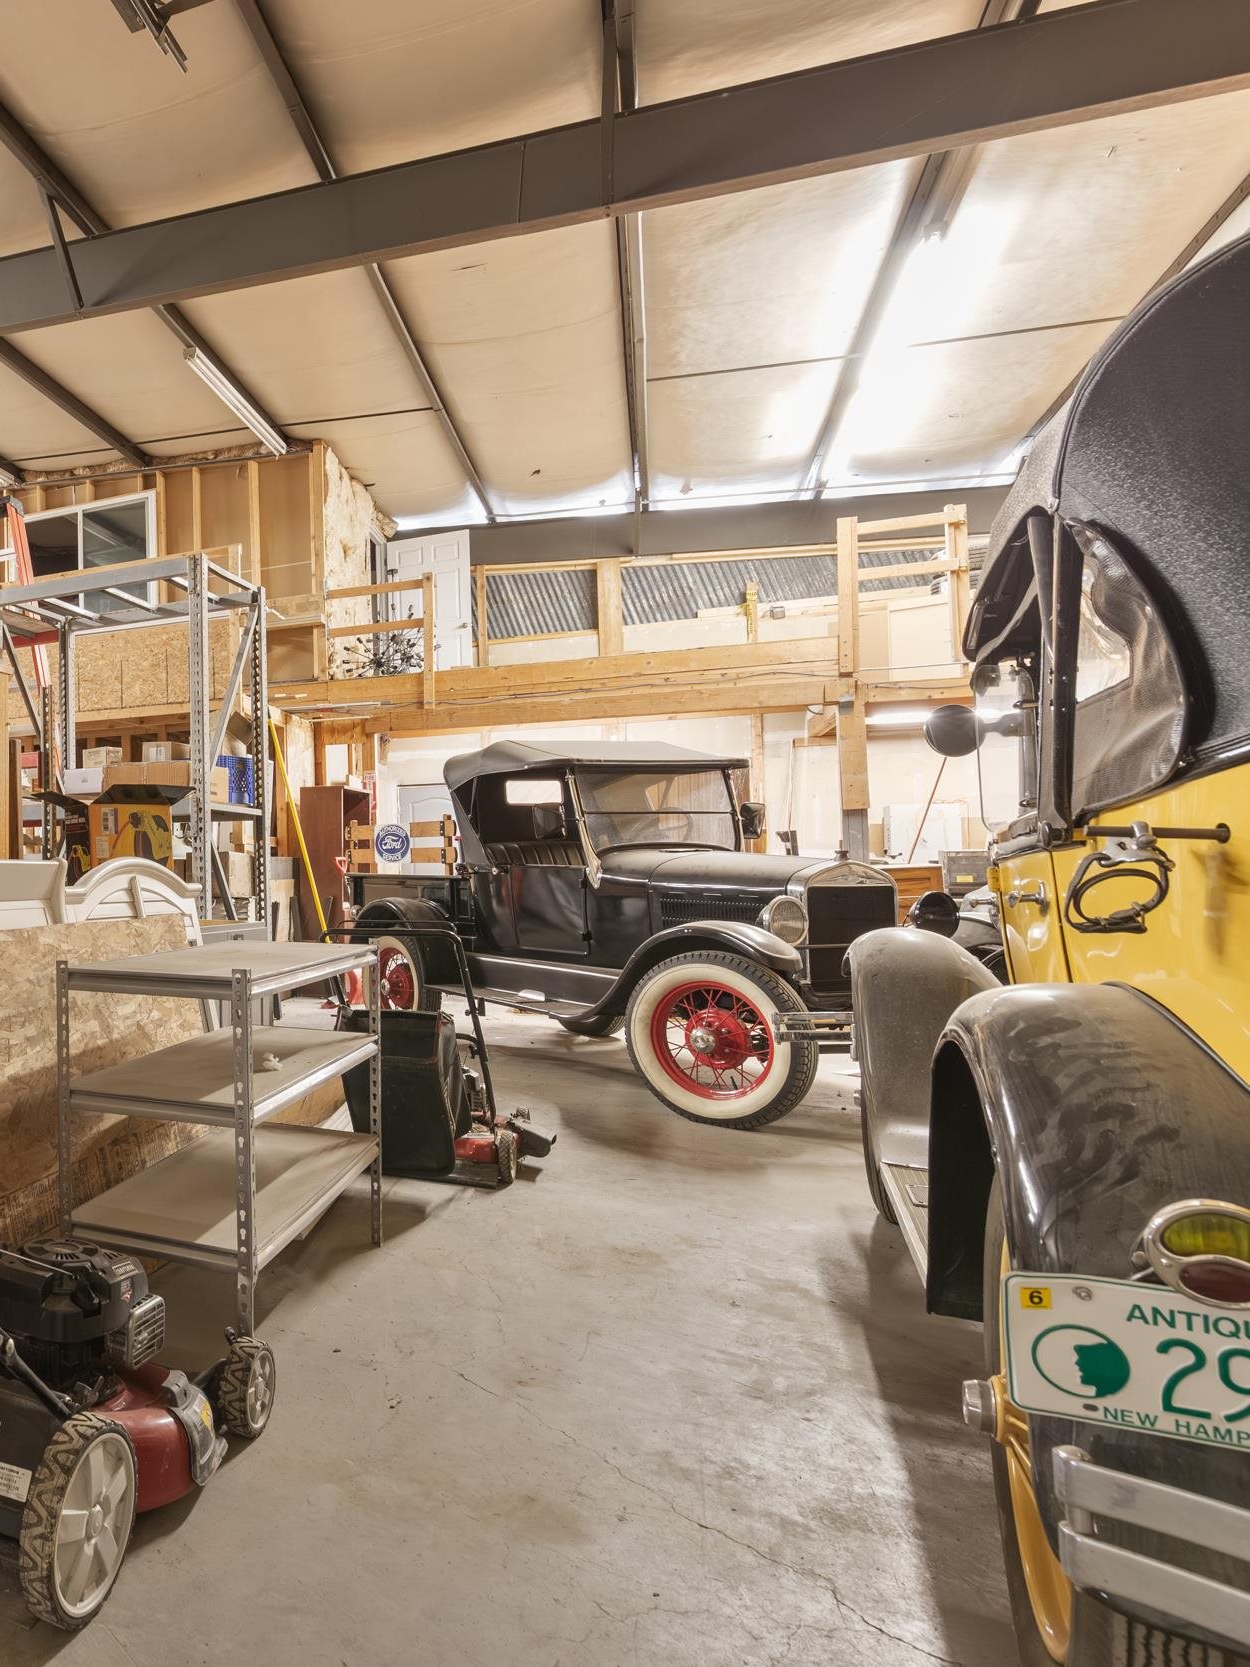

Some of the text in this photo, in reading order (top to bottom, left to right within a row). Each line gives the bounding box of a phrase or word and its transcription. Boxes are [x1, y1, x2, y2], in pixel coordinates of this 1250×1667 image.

[379, 825, 407, 837] AUTHORIZED
[381, 835, 403, 850] Ford
[382, 852, 402, 861] SERVICE
[1029, 1290, 1043, 1305] 6
[1156, 1338, 1250, 1423] 29
[1103, 1406, 1159, 1428] NEW
